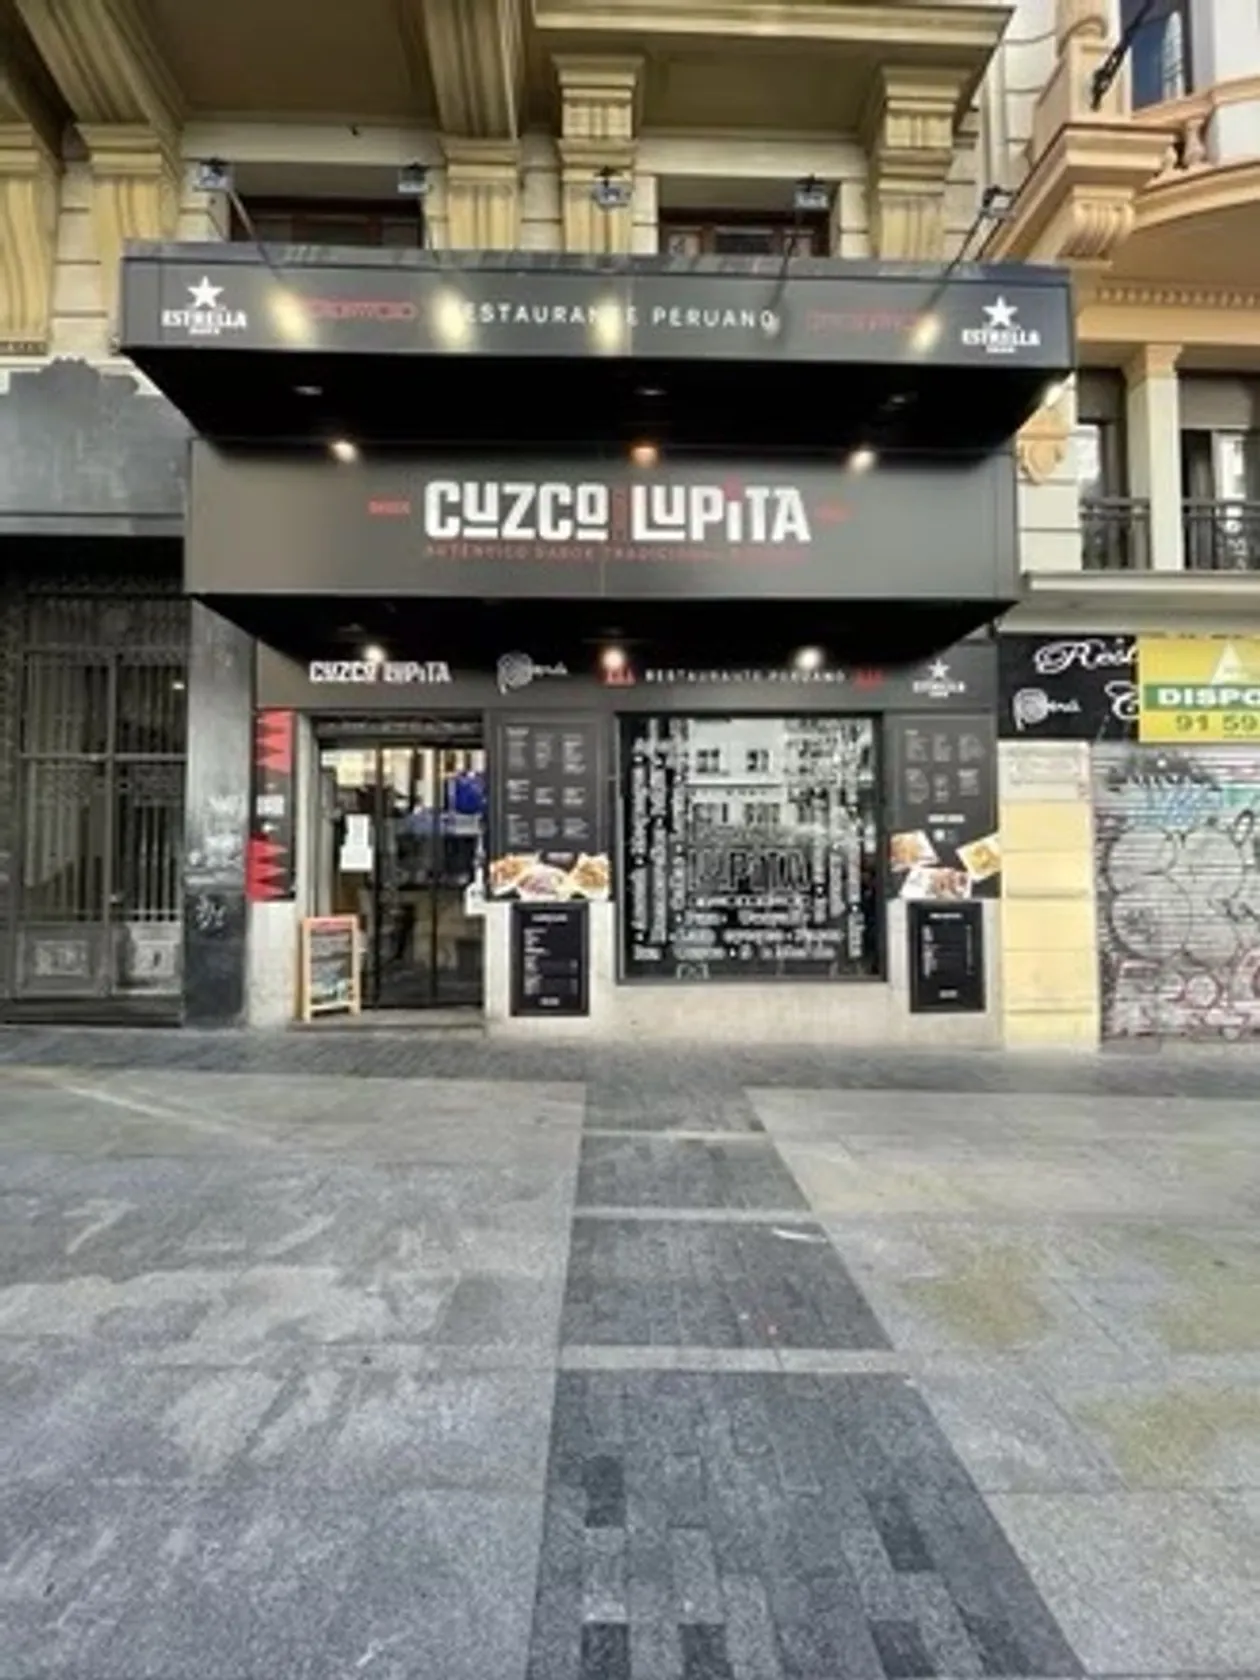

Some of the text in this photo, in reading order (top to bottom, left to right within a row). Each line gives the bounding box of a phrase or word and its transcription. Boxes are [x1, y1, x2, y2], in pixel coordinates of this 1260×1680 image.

[161, 309, 247, 328] ESTRELLA
[447, 303, 777, 330] ESTAURANE PERUANO
[961, 327, 1041, 347] ESTRELLA
[424, 480, 609, 541] CUZCO
[1175, 714, 1259, 732] 91 59
